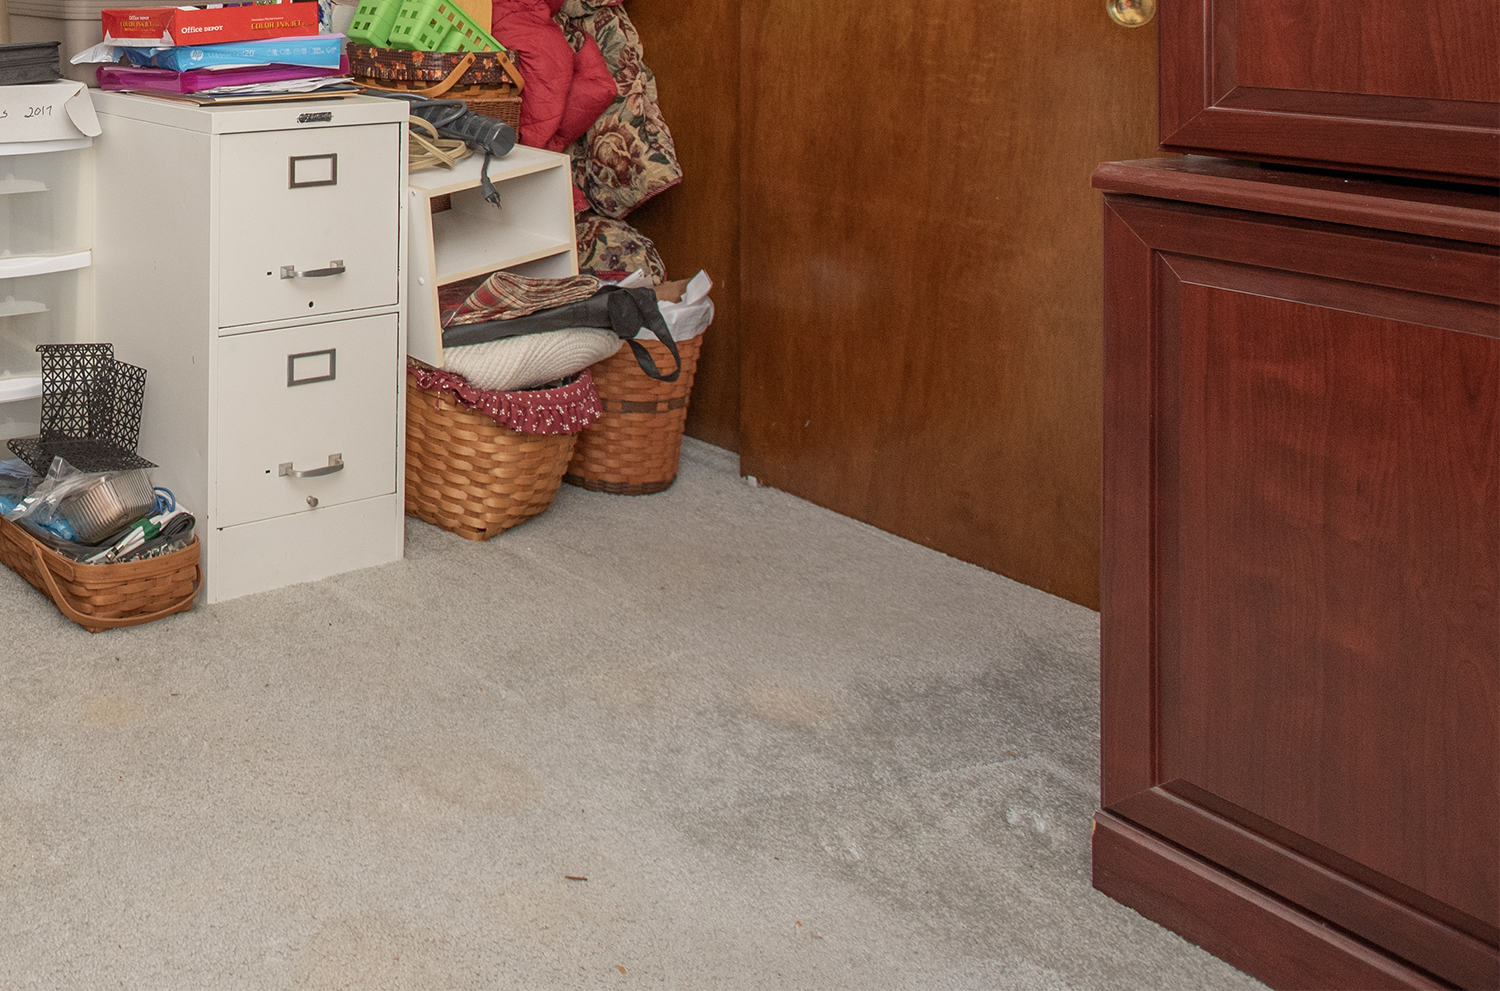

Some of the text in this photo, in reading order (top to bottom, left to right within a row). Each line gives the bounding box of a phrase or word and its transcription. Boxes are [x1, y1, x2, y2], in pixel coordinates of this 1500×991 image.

[181, 26, 203, 34] Office
[251, 20, 302, 30] COLOR INKJET
[24, 105, 52, 118] 2017
